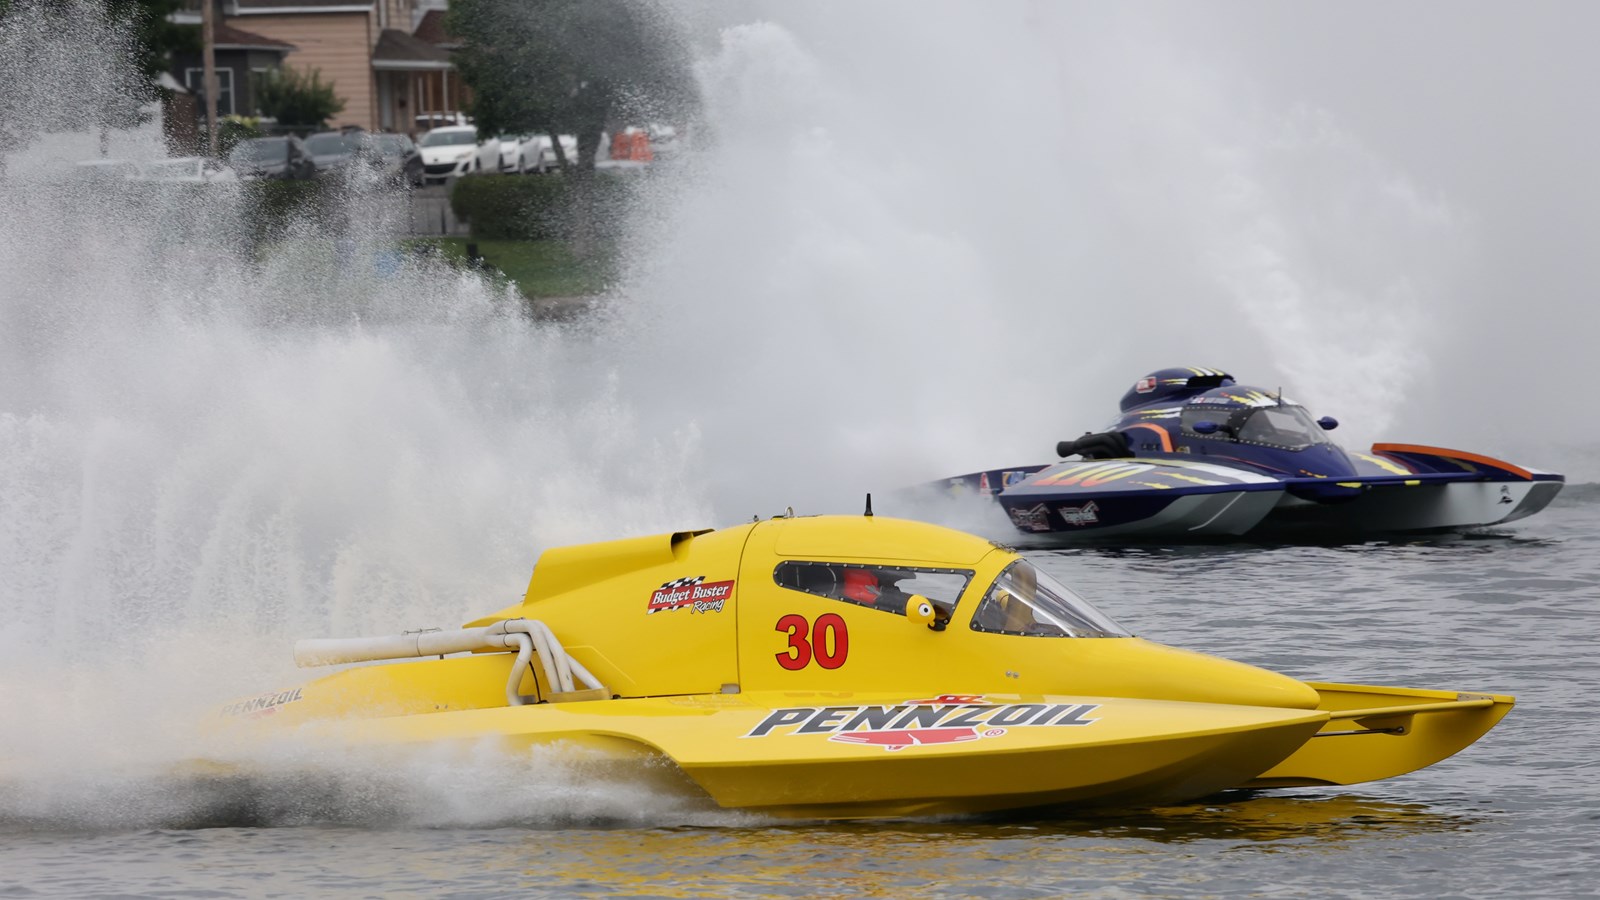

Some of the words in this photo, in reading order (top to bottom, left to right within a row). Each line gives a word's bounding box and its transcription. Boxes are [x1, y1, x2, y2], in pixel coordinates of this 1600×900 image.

[652, 589, 690, 605] Budget
[692, 586, 729, 599] Buster
[691, 598, 725, 615] Racing
[775, 614, 848, 670] 30
[220, 688, 303, 717] PENNZOIL
[740, 704, 1102, 737] PENNZOIL
